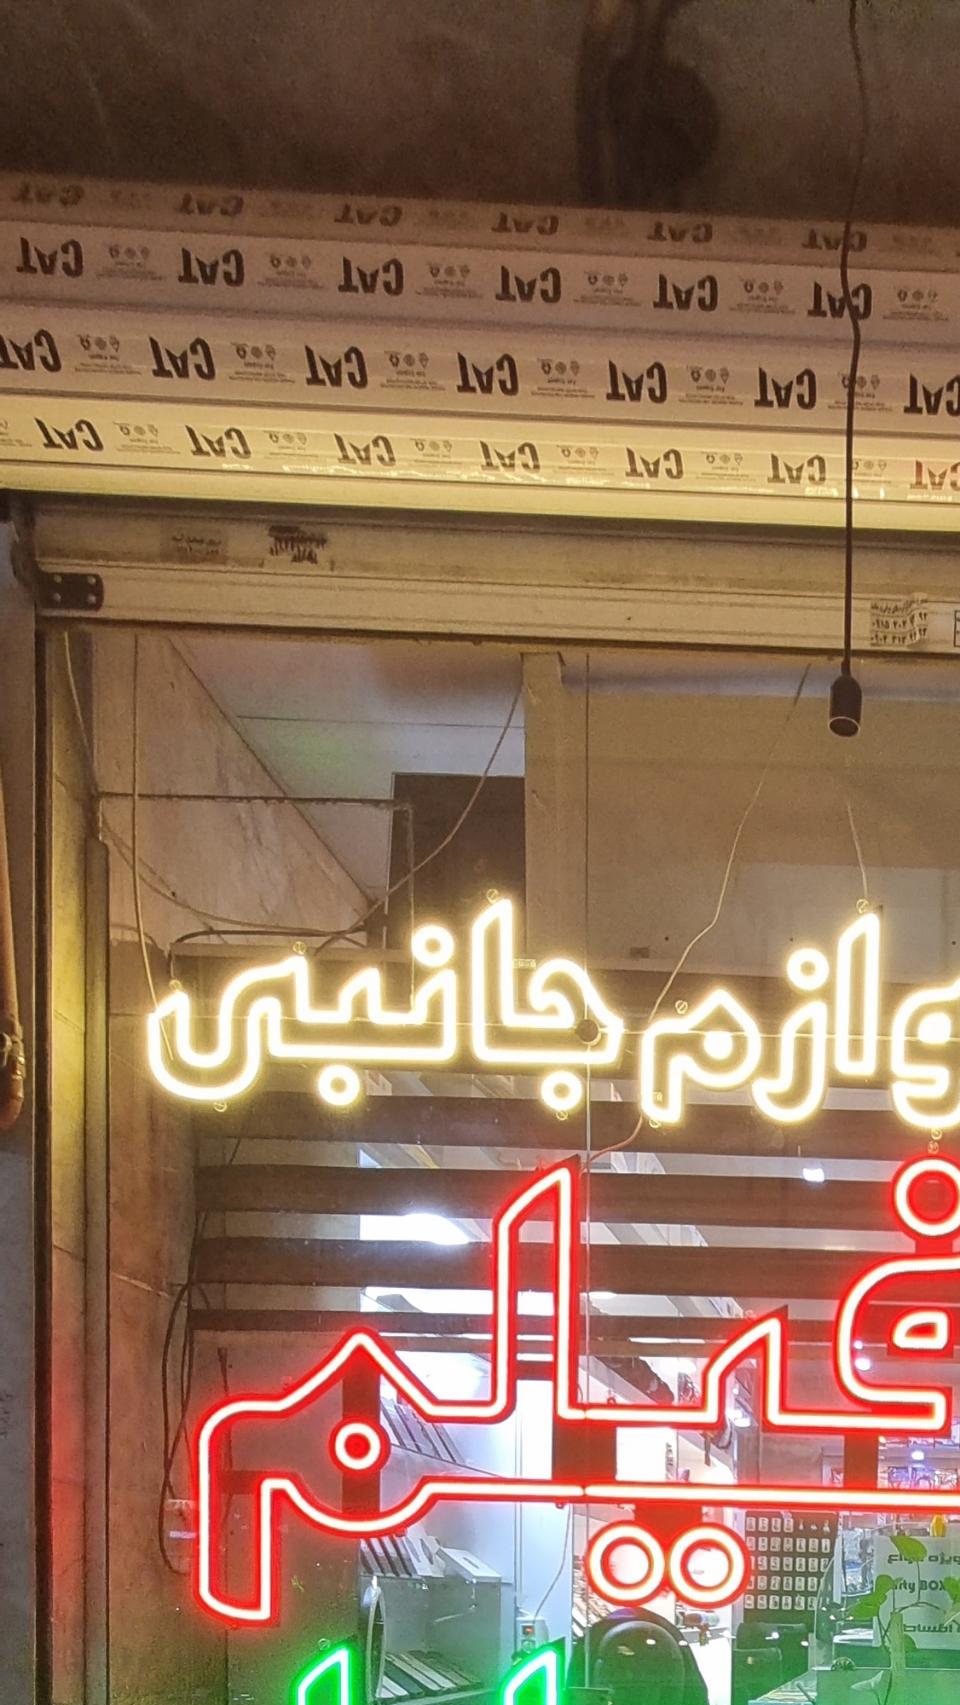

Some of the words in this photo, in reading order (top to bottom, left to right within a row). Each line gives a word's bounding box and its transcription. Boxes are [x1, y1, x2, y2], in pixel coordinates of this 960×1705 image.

[16, 237, 83, 278] CAT
[178, 248, 244, 286] CAT
[338, 256, 403, 296] CAT
[496, 266, 561, 303] CAT
[653, 274, 718, 311] CAT
[808, 281, 872, 320] CAT
[0, 329, 61, 372] CAT
[149, 337, 215, 380] CAT
[305, 345, 368, 389] CAT
[457, 352, 518, 396] CAT
[606, 360, 667, 403] CAT
[754, 368, 816, 409] CAT
[35, 418, 103, 451] CAT
[186, 426, 251, 458] CAT
[335, 434, 395, 464] CAT
[480, 439, 540, 474] CAT
[626, 448, 683, 479] CAT
[768, 454, 825, 483] CAT
[147, 898, 624, 1111] جانبی
